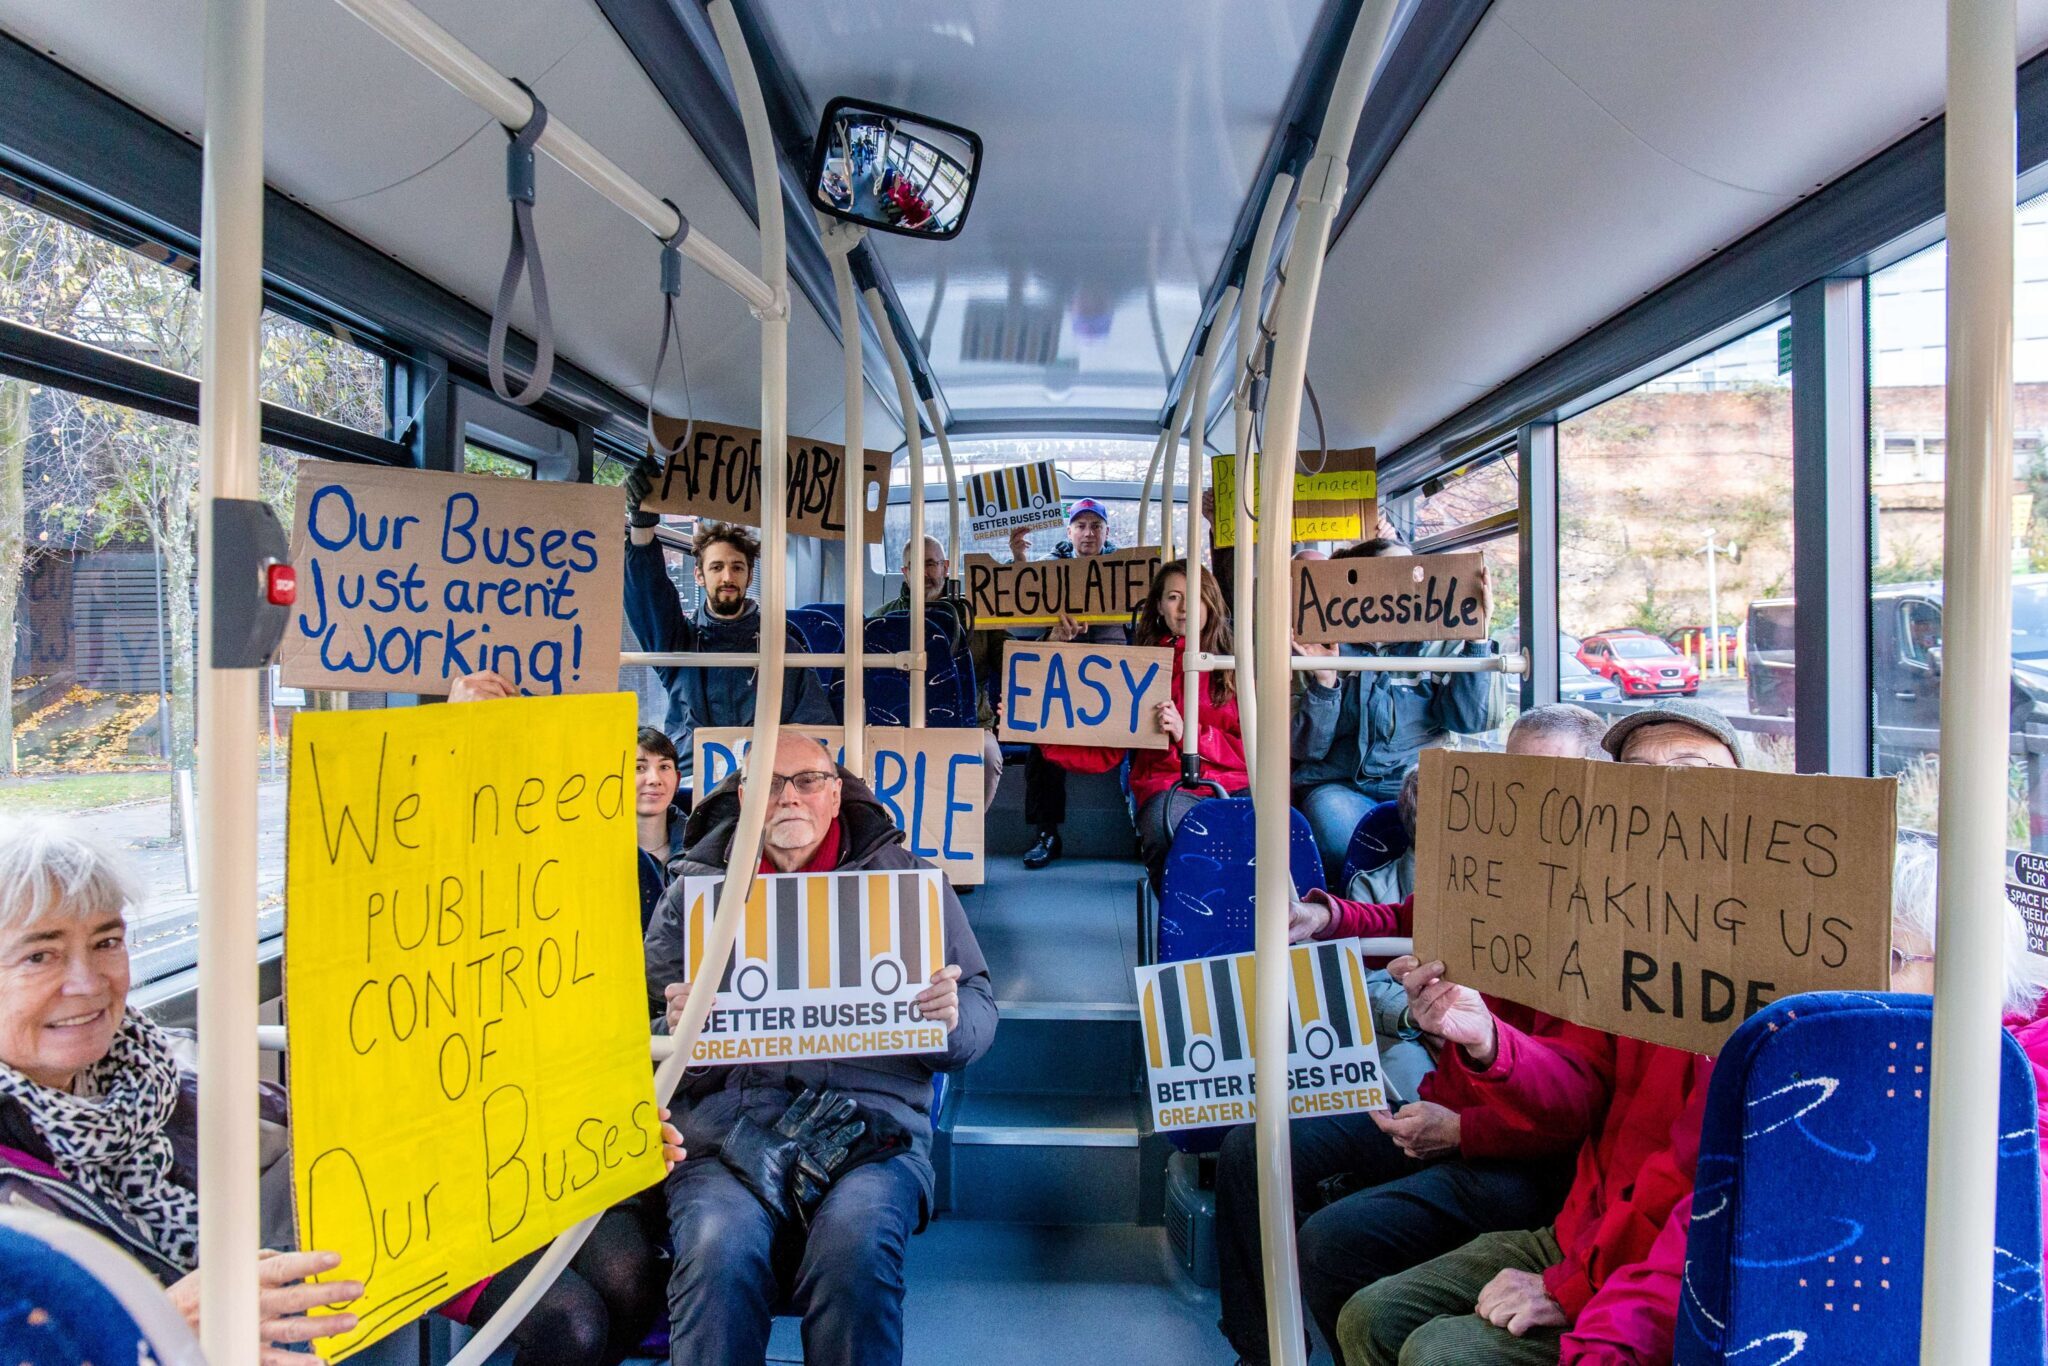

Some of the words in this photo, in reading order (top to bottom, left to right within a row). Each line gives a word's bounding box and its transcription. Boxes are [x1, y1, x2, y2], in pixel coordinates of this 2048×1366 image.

[661, 432, 877, 532] AFFORABL
[973, 517, 1009, 531] BETTER
[1010, 512, 1041, 525] BUSES
[1042, 508, 1062, 519] FOR
[308, 485, 420, 551] Our
[441, 492, 599, 572] Buses
[974, 529, 1009, 540] GREATER
[299, 558, 429, 638] Just
[1297, 566, 1479, 636] Accessible
[1006, 652, 1160, 734] EASY
[472, 750, 627, 844] need
[1447, 765, 1525, 838] BUS
[1539, 787, 1838, 877] COMPANIES
[367, 859, 560, 963] PUBLIC
[1446, 853, 1503, 899] ARE
[1538, 861, 1748, 946] TAKING
[1779, 908, 1853, 968] US
[2011, 888, 2040, 908] SPACE
[2026, 871, 2047, 888] FOR
[349, 929, 596, 1055] CONTROL
[1470, 917, 1536, 980] FOR
[1557, 939, 1590, 1000] A
[692, 1036, 793, 1061] GREATER
[798, 1027, 944, 1056] MANCHESTER
[802, 1001, 888, 1030] BUSES
[894, 999, 943, 1024] FO
[439, 1018, 504, 1101] OF
[1156, 1075, 1243, 1104] BETTER
[1330, 1060, 1378, 1091] FOR
[1158, 1102, 1245, 1127] GREATER
[309, 1146, 440, 1310] Our
